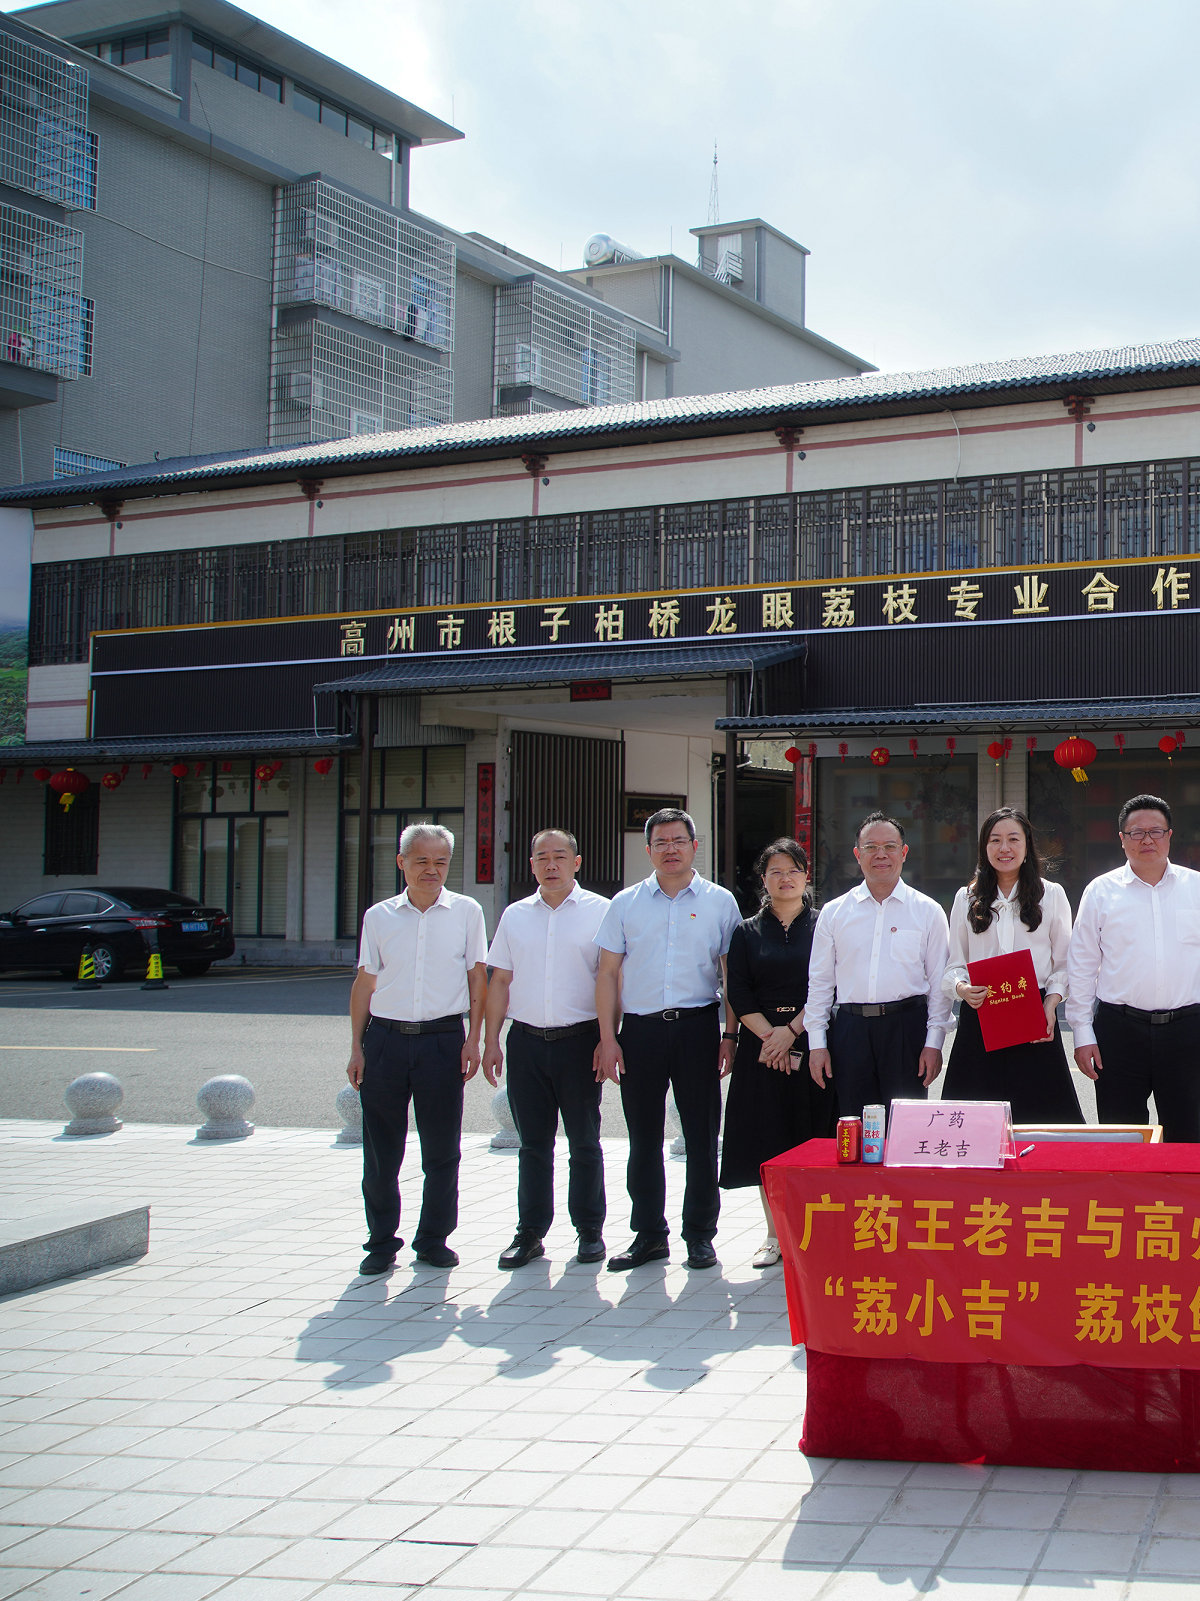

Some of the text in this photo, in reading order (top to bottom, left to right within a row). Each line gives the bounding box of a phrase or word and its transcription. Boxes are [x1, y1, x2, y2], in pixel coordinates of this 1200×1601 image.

[927, 1110, 965, 1129] 广药
[842, 1128, 851, 1158] 王老吉
[914, 1140, 971, 1158] 王老吉
[824, 1275, 1040, 1340] “荔小吉”
